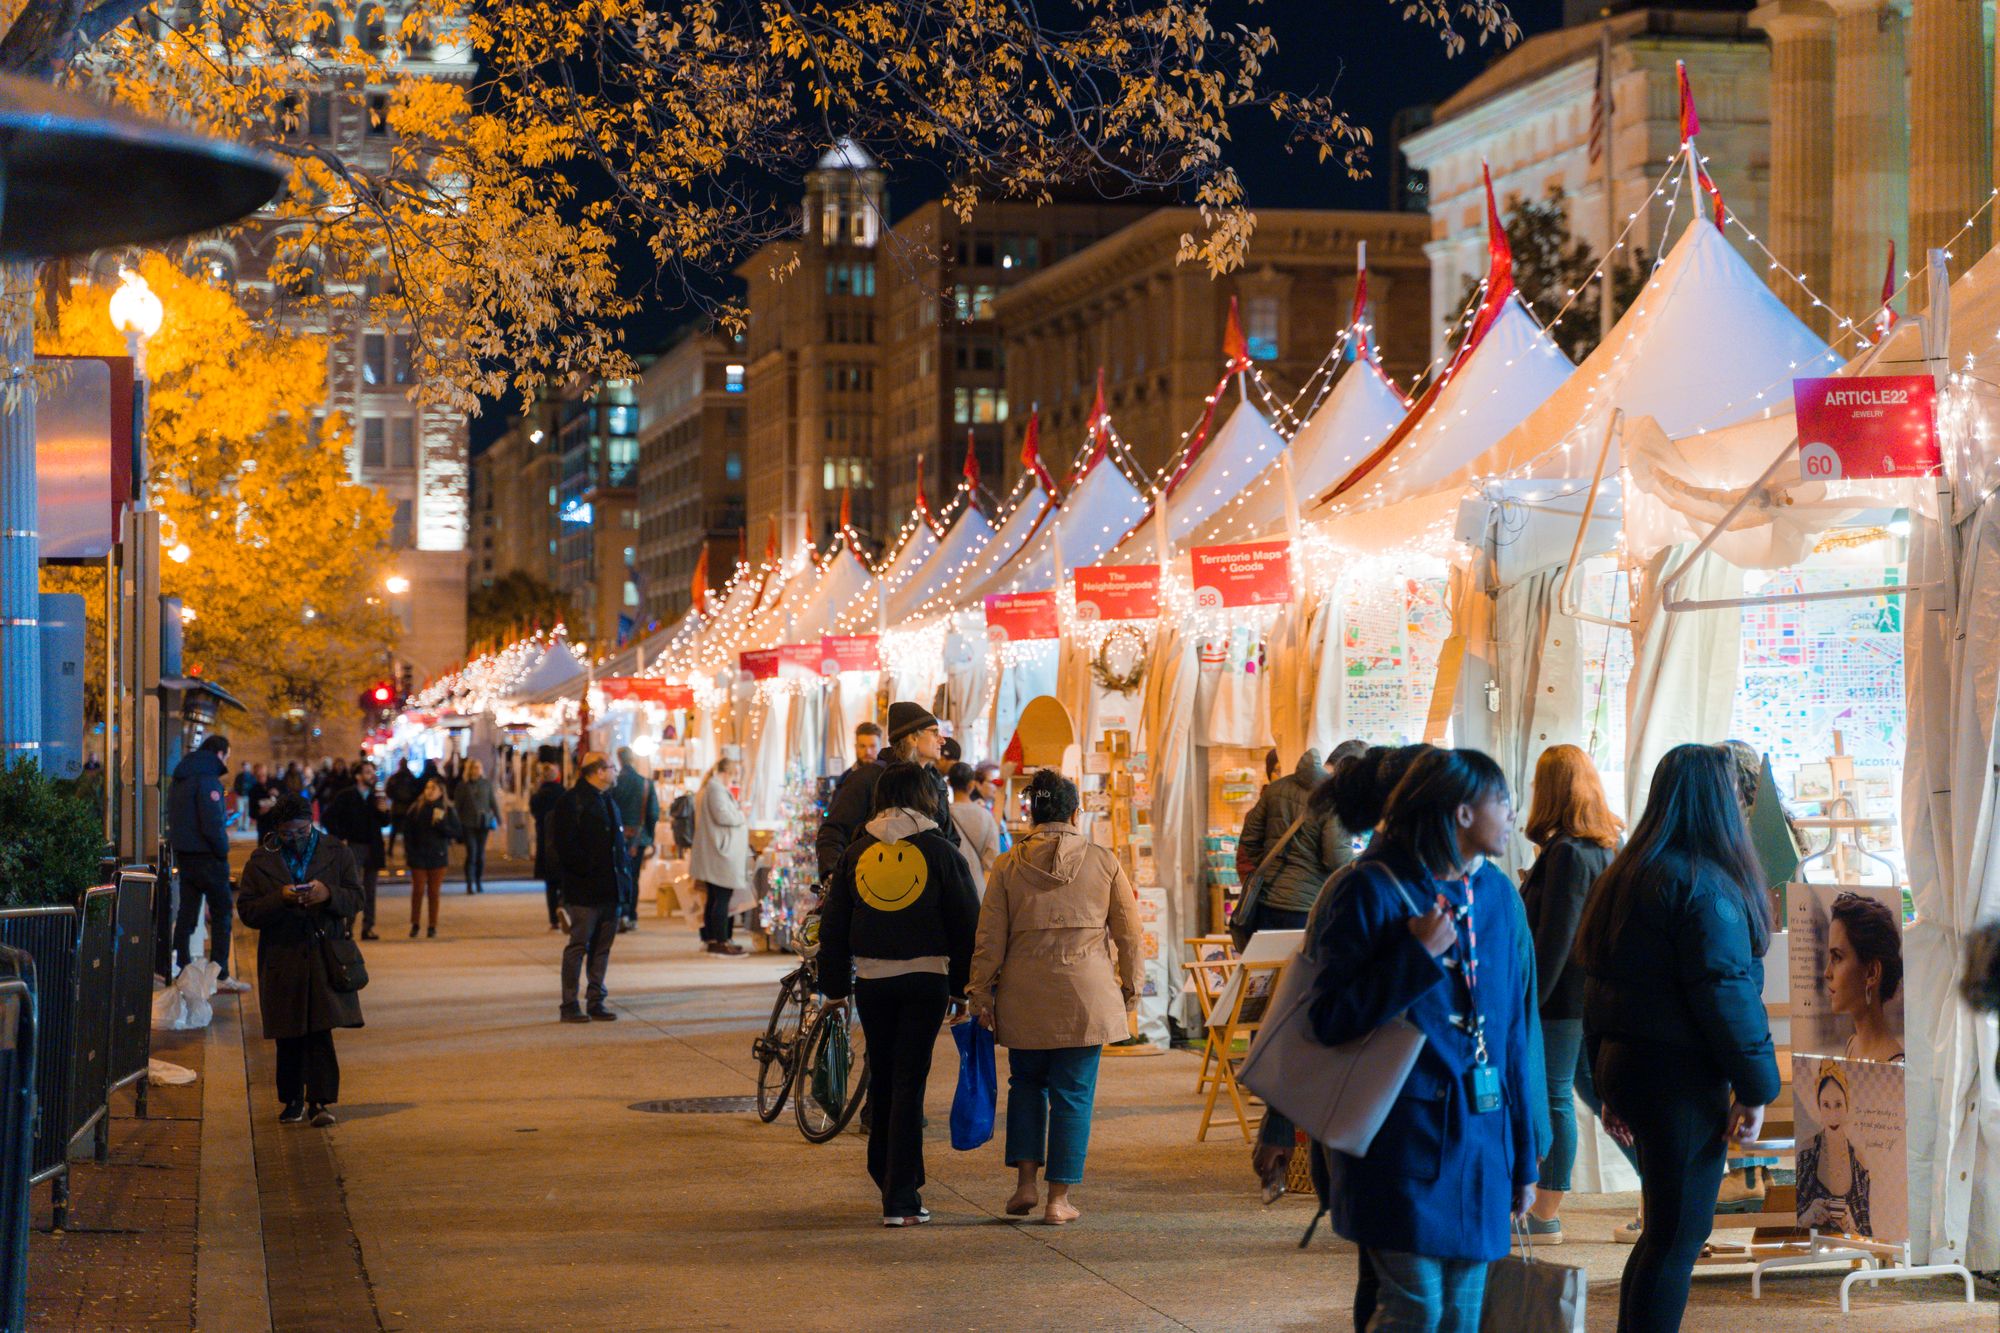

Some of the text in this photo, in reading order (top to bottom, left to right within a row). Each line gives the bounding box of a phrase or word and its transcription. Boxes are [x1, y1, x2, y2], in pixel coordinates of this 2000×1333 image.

[1824, 389, 1909, 406] ARTICLE22
[1851, 410, 1884, 418] JEWELRY
[1807, 455, 1833, 475] 60
[1200, 550, 1282, 564] Terratorie Maps
[1229, 562, 1264, 573] Goods
[1108, 572, 1127, 581] The
[1199, 594, 1216, 606] 58
